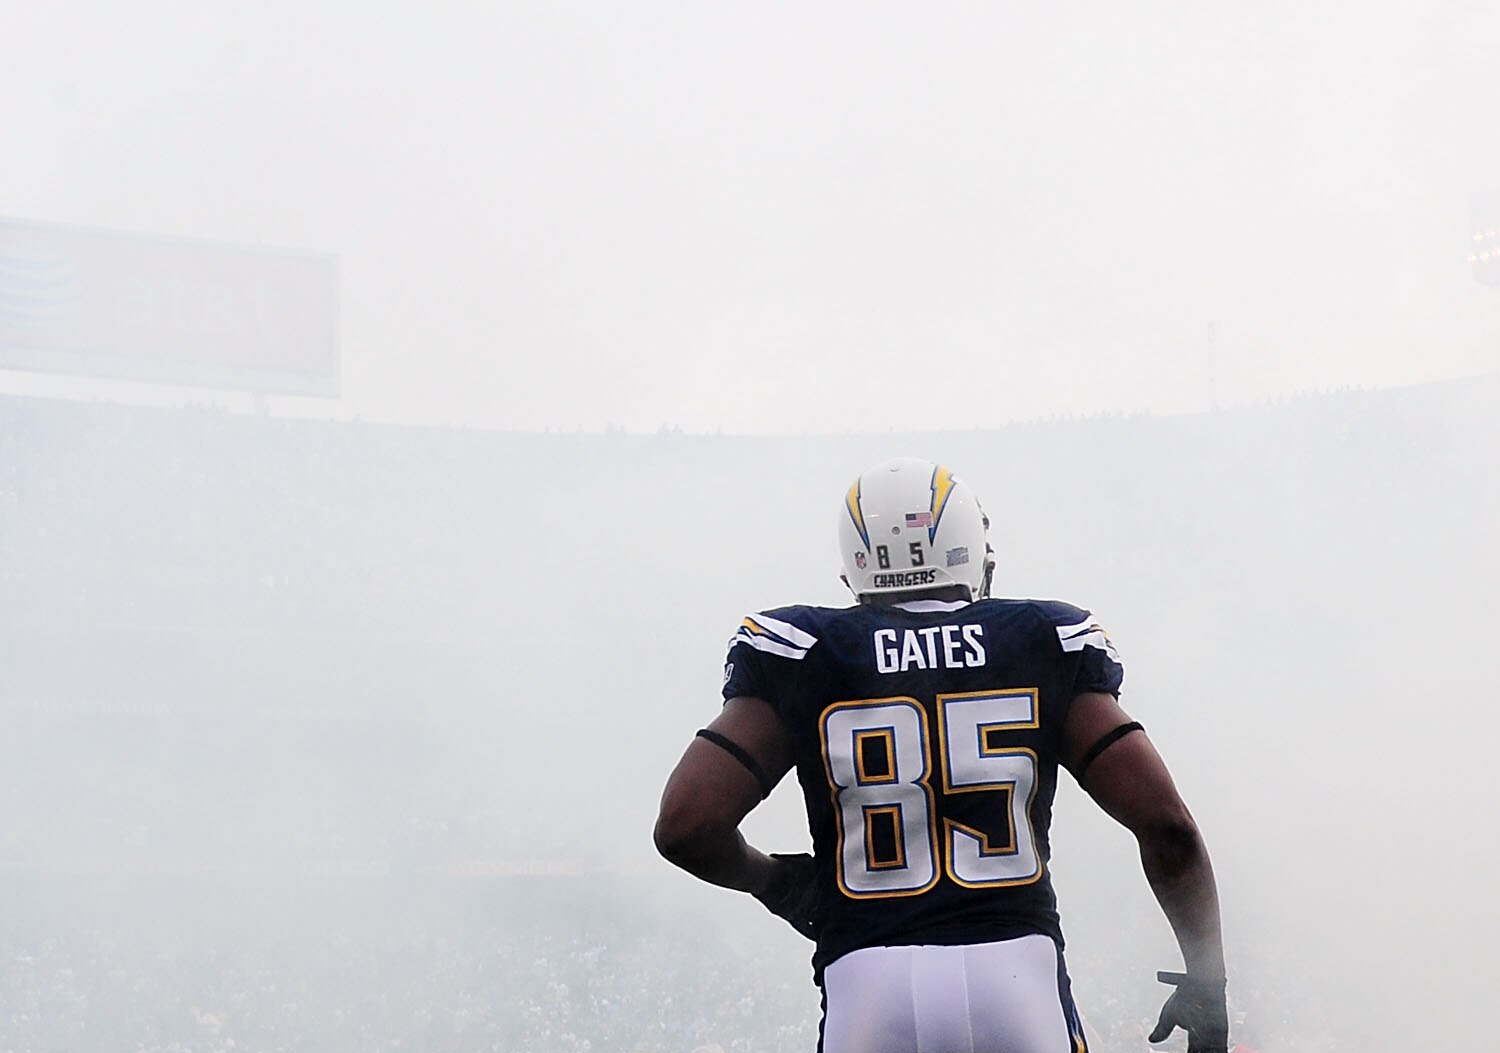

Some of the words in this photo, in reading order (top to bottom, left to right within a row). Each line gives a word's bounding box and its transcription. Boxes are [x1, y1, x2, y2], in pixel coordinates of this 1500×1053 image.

[874, 570, 936, 588] CHARGERS
[874, 624, 985, 673] GATES
[818, 687, 1043, 899] 85
